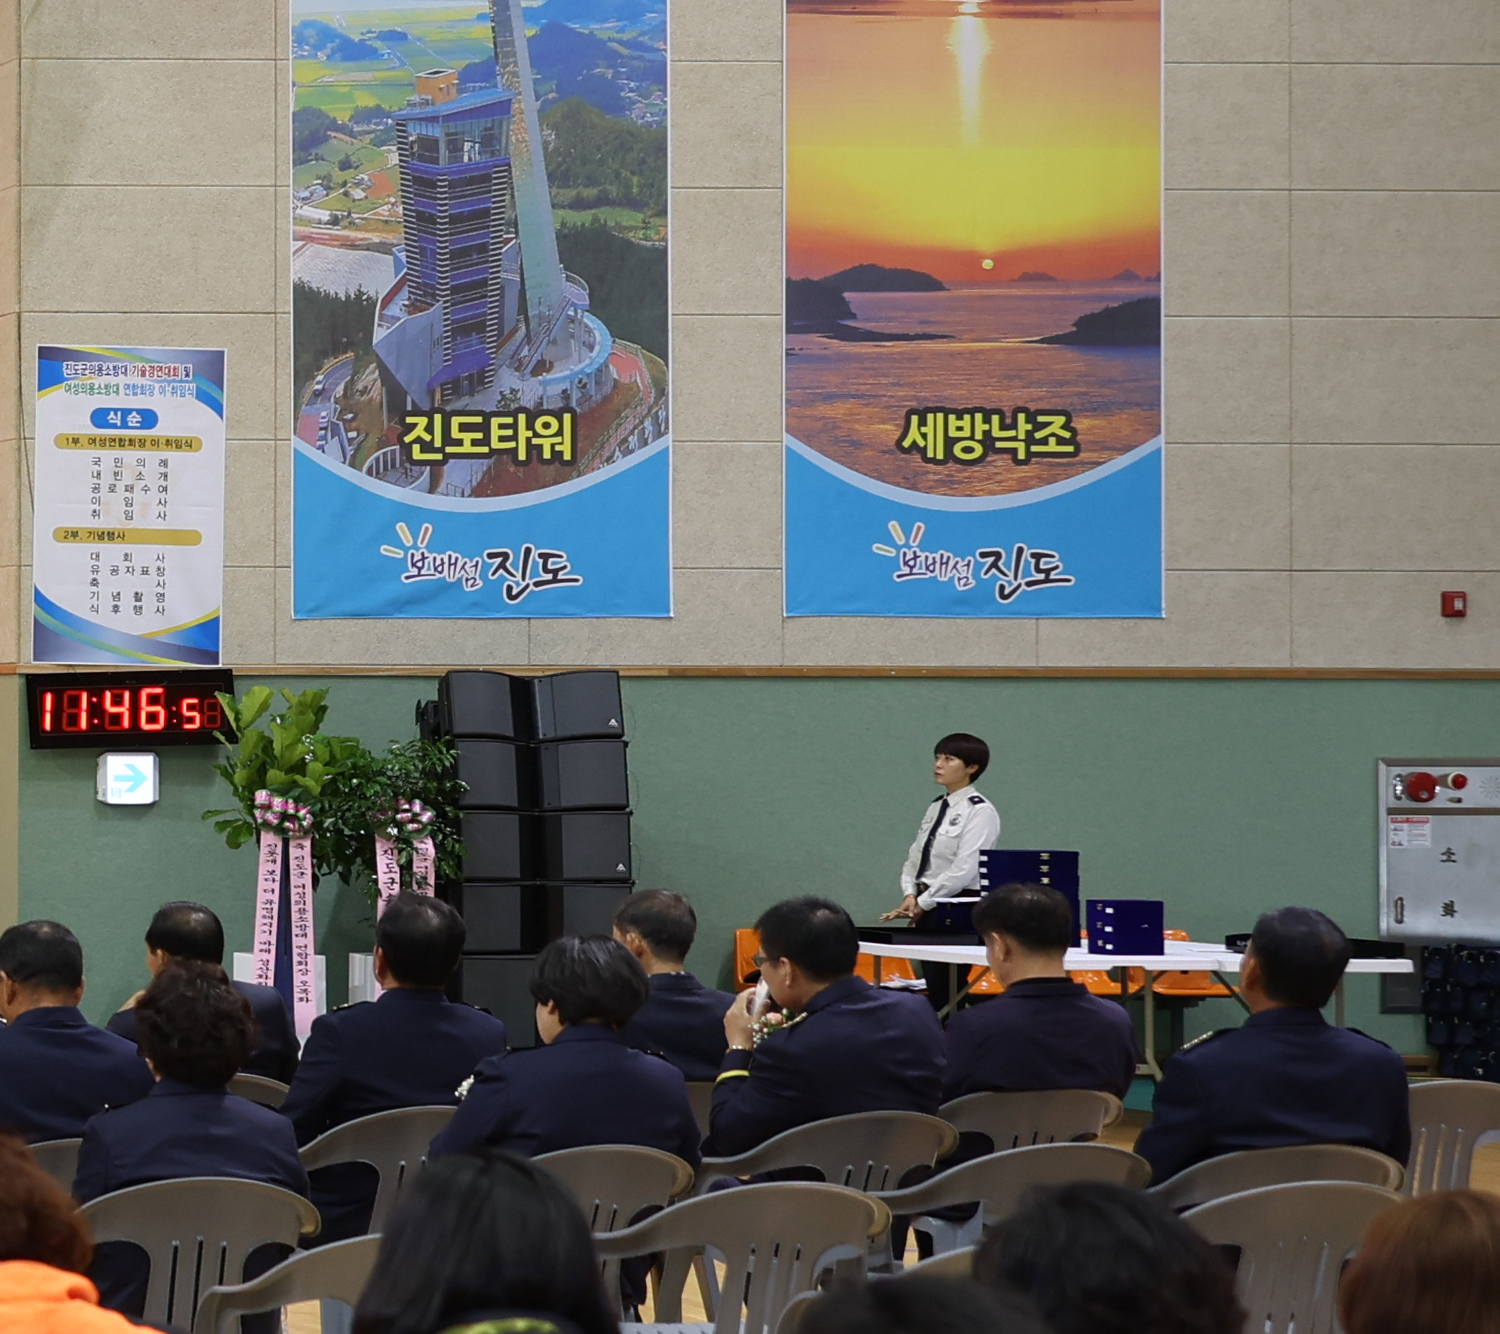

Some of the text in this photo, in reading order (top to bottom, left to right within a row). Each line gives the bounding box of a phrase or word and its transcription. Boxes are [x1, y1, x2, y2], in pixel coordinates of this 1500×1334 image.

[64, 363, 128, 378] 진도군의용소방대
[131, 364, 179, 378] 기술경연대회
[64, 382, 120, 396] 여성의용소방대
[123, 383, 155, 397] 연합회장
[88, 437, 147, 449] 여성연합회장
[401, 410, 577, 462] 진도타워
[901, 409, 1077, 461] 세방낙조
[86, 530, 126, 542] 기념행사
[487, 547, 582, 601] 진도
[979, 547, 1073, 601] 진도
